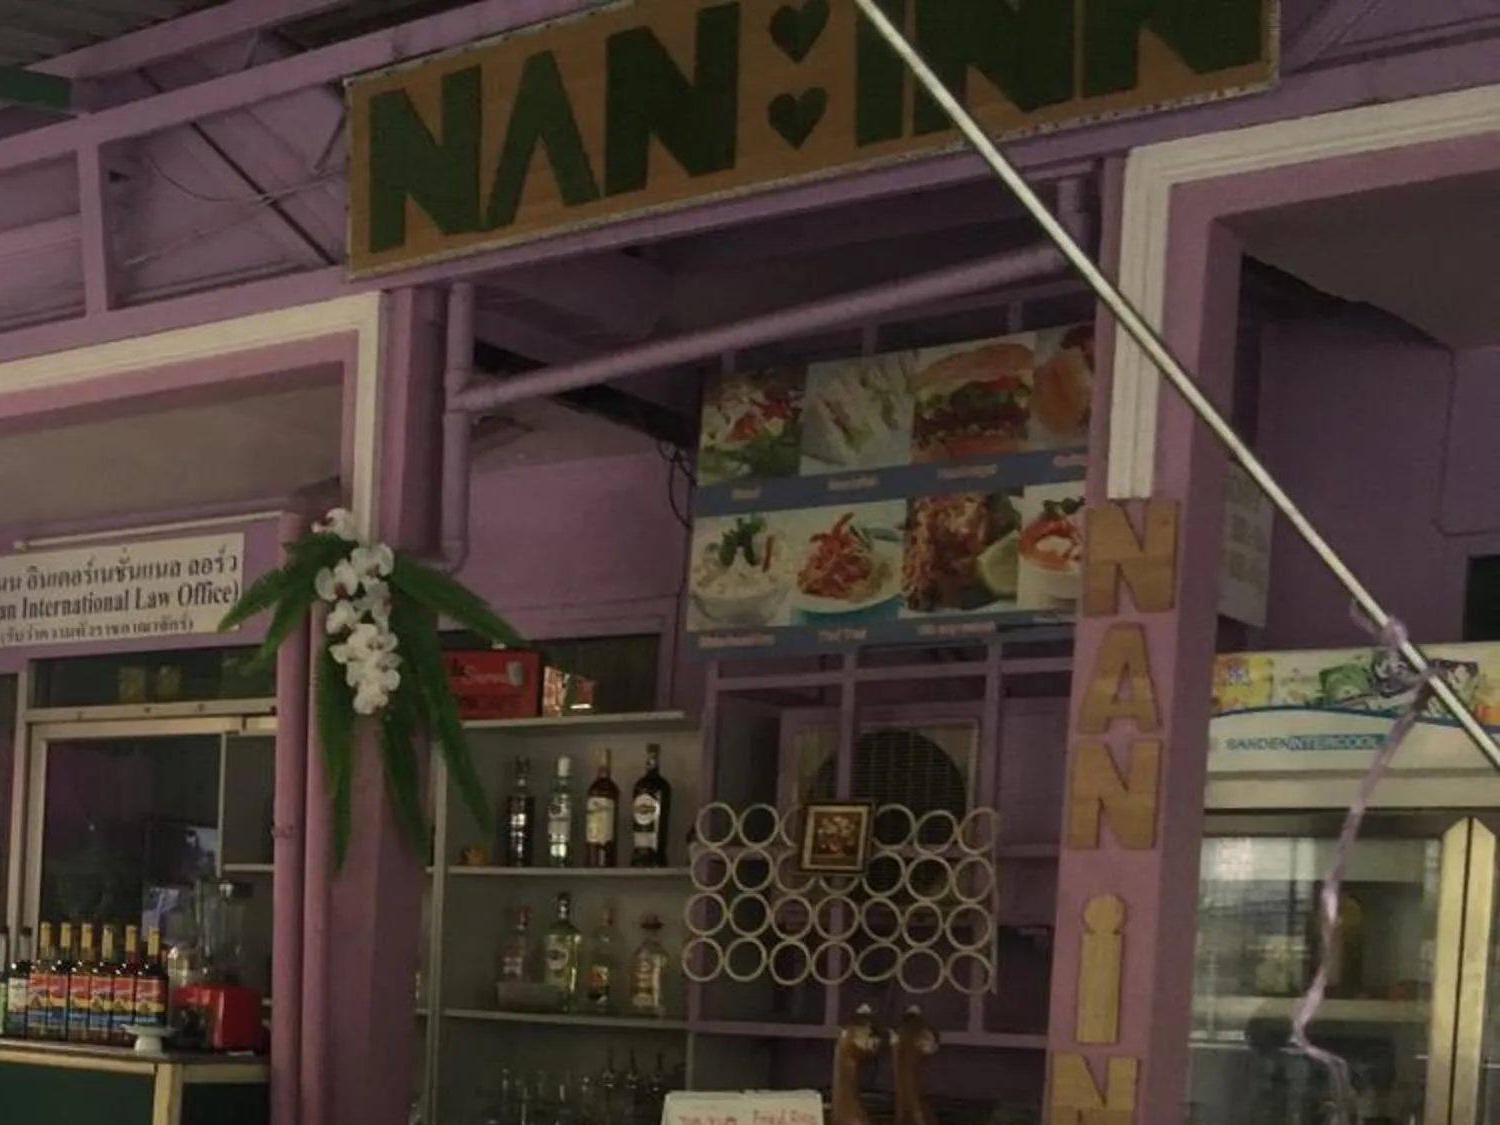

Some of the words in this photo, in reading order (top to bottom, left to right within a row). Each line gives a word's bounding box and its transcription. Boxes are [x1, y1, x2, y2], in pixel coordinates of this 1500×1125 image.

[369, 2, 741, 254] NAN
[22, 590, 130, 620] International
[134, 587, 171, 610] Law
[177, 579, 240, 607] Office)
[1067, 498, 1178, 852] NAN
